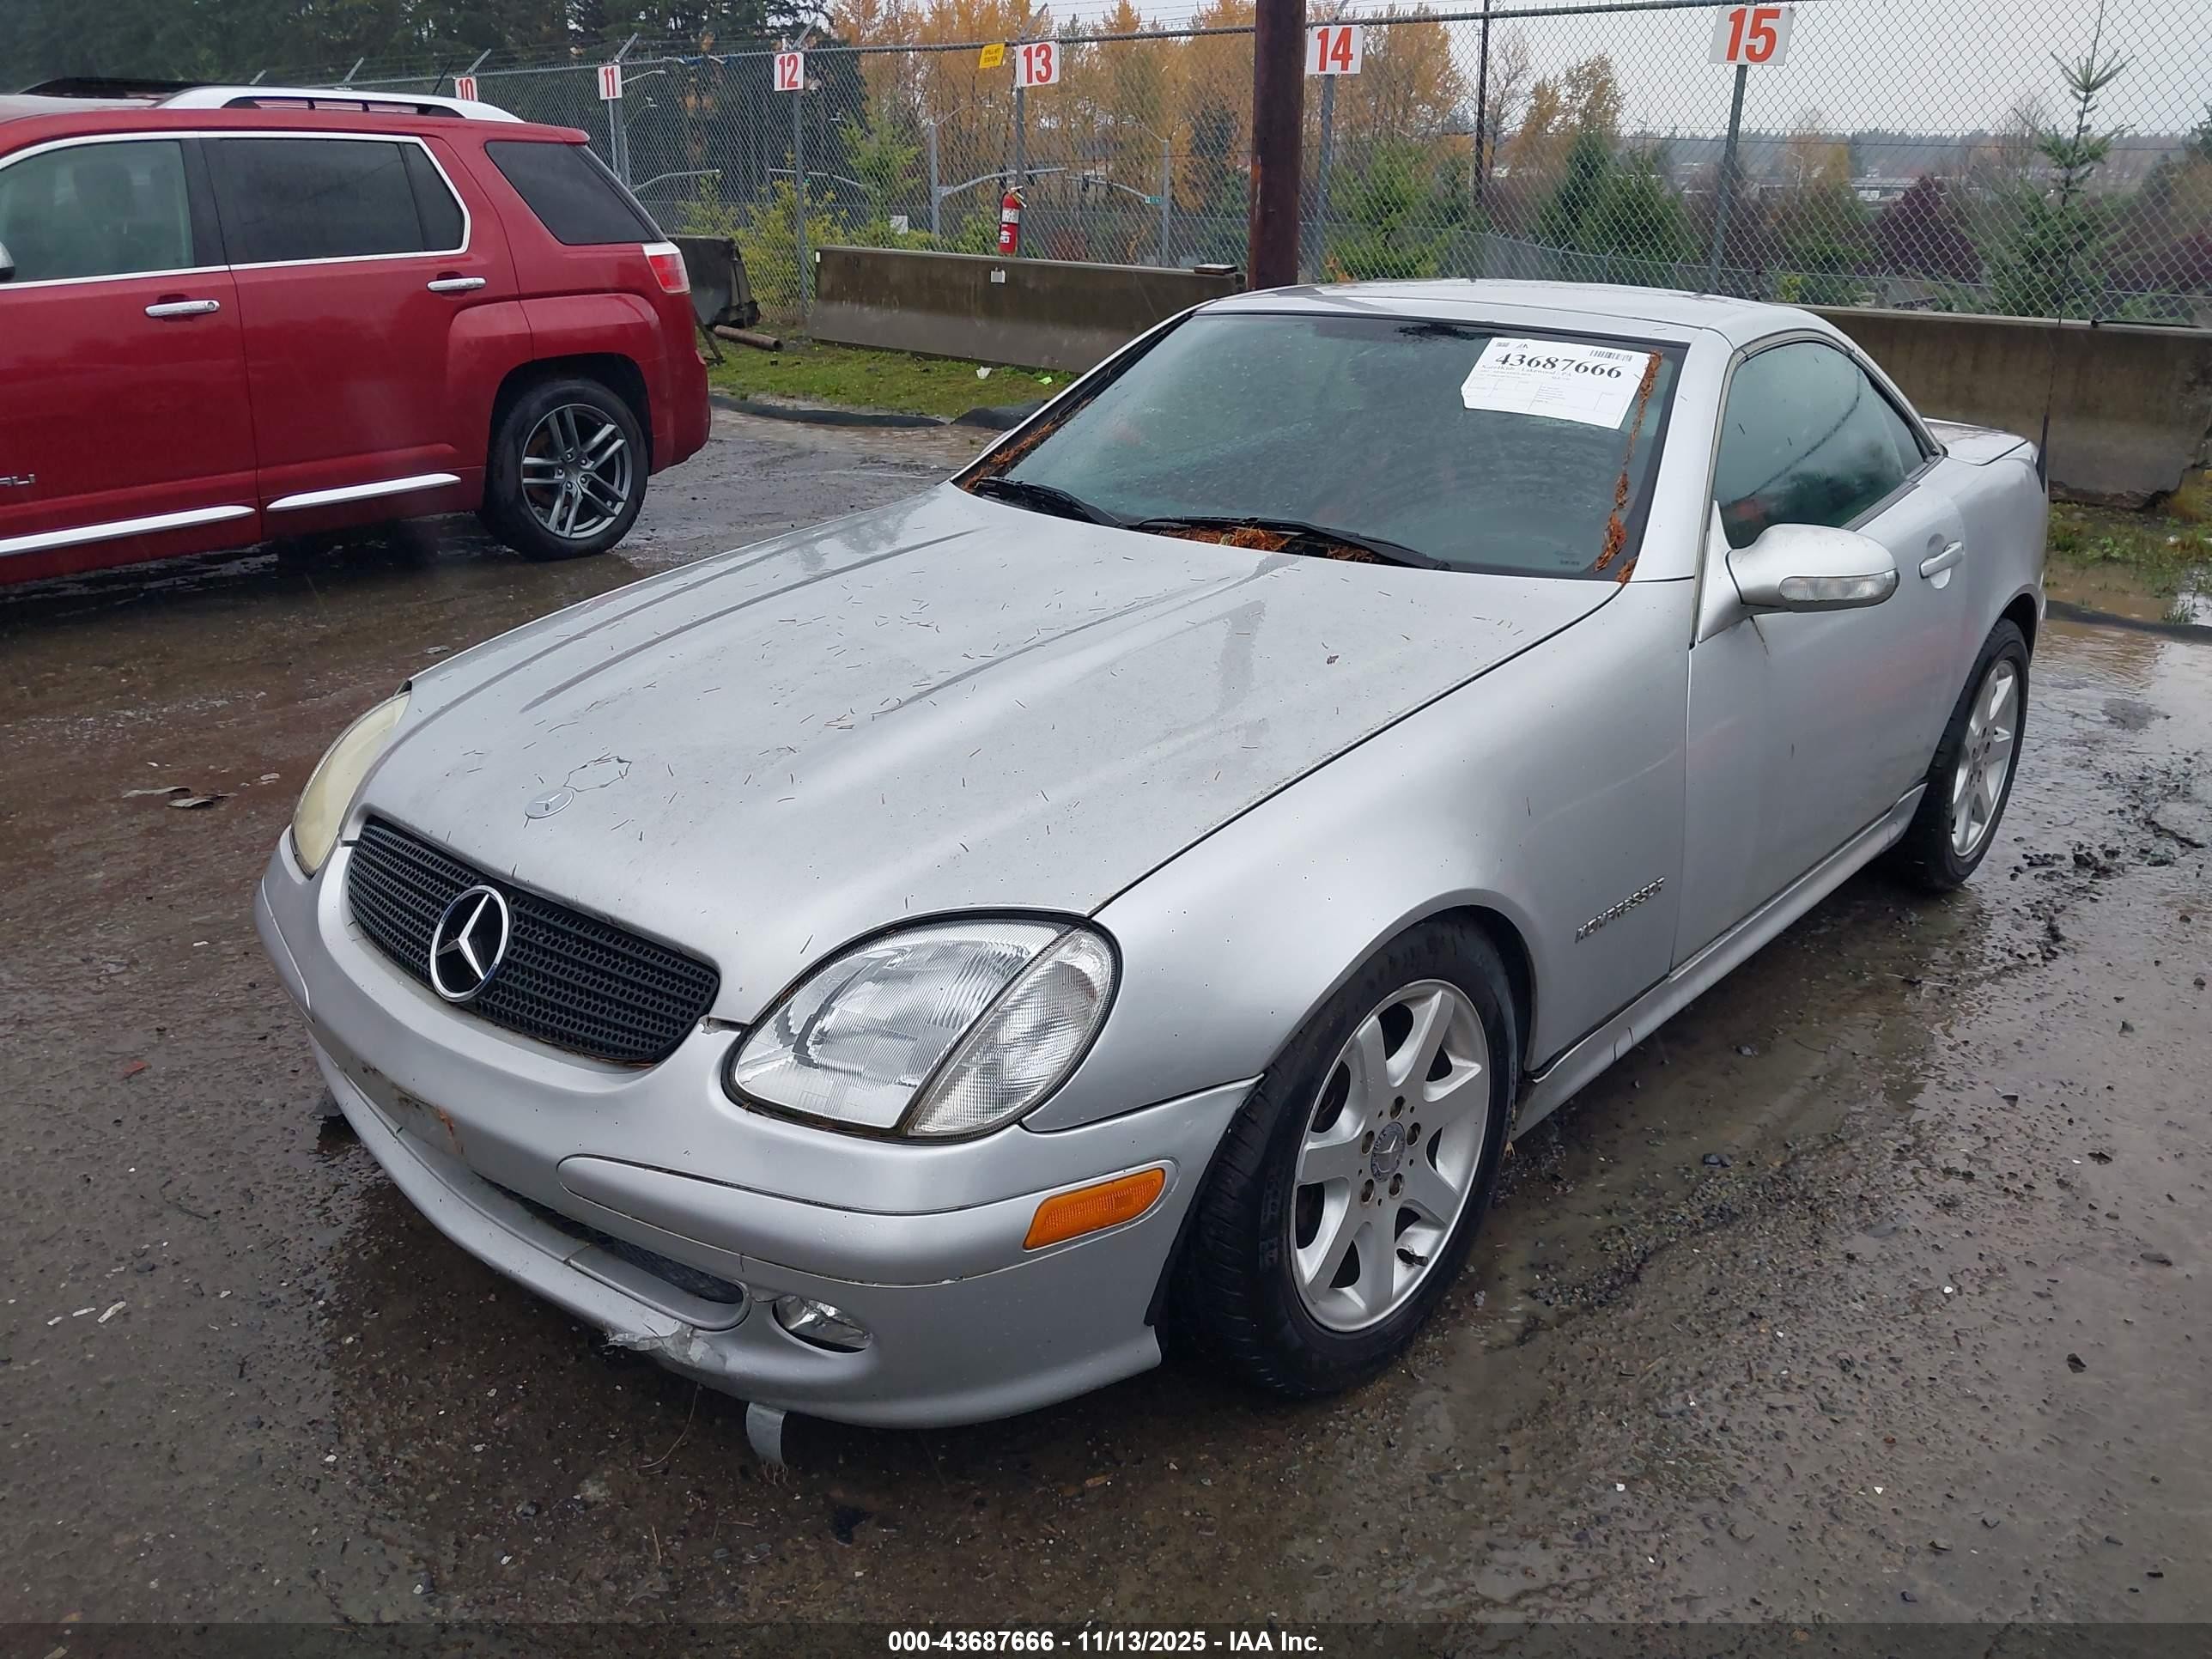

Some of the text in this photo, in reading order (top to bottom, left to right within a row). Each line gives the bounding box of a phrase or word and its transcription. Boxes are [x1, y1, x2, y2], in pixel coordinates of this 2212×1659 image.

[1316, 27, 1354, 72] 14
[1726, 8, 1782, 64] 15
[779, 54, 799, 88] 12
[1023, 43, 1053, 84] 13
[458, 78, 475, 101] 10
[603, 67, 617, 98] 11
[1495, 353, 1626, 379] 43687666
